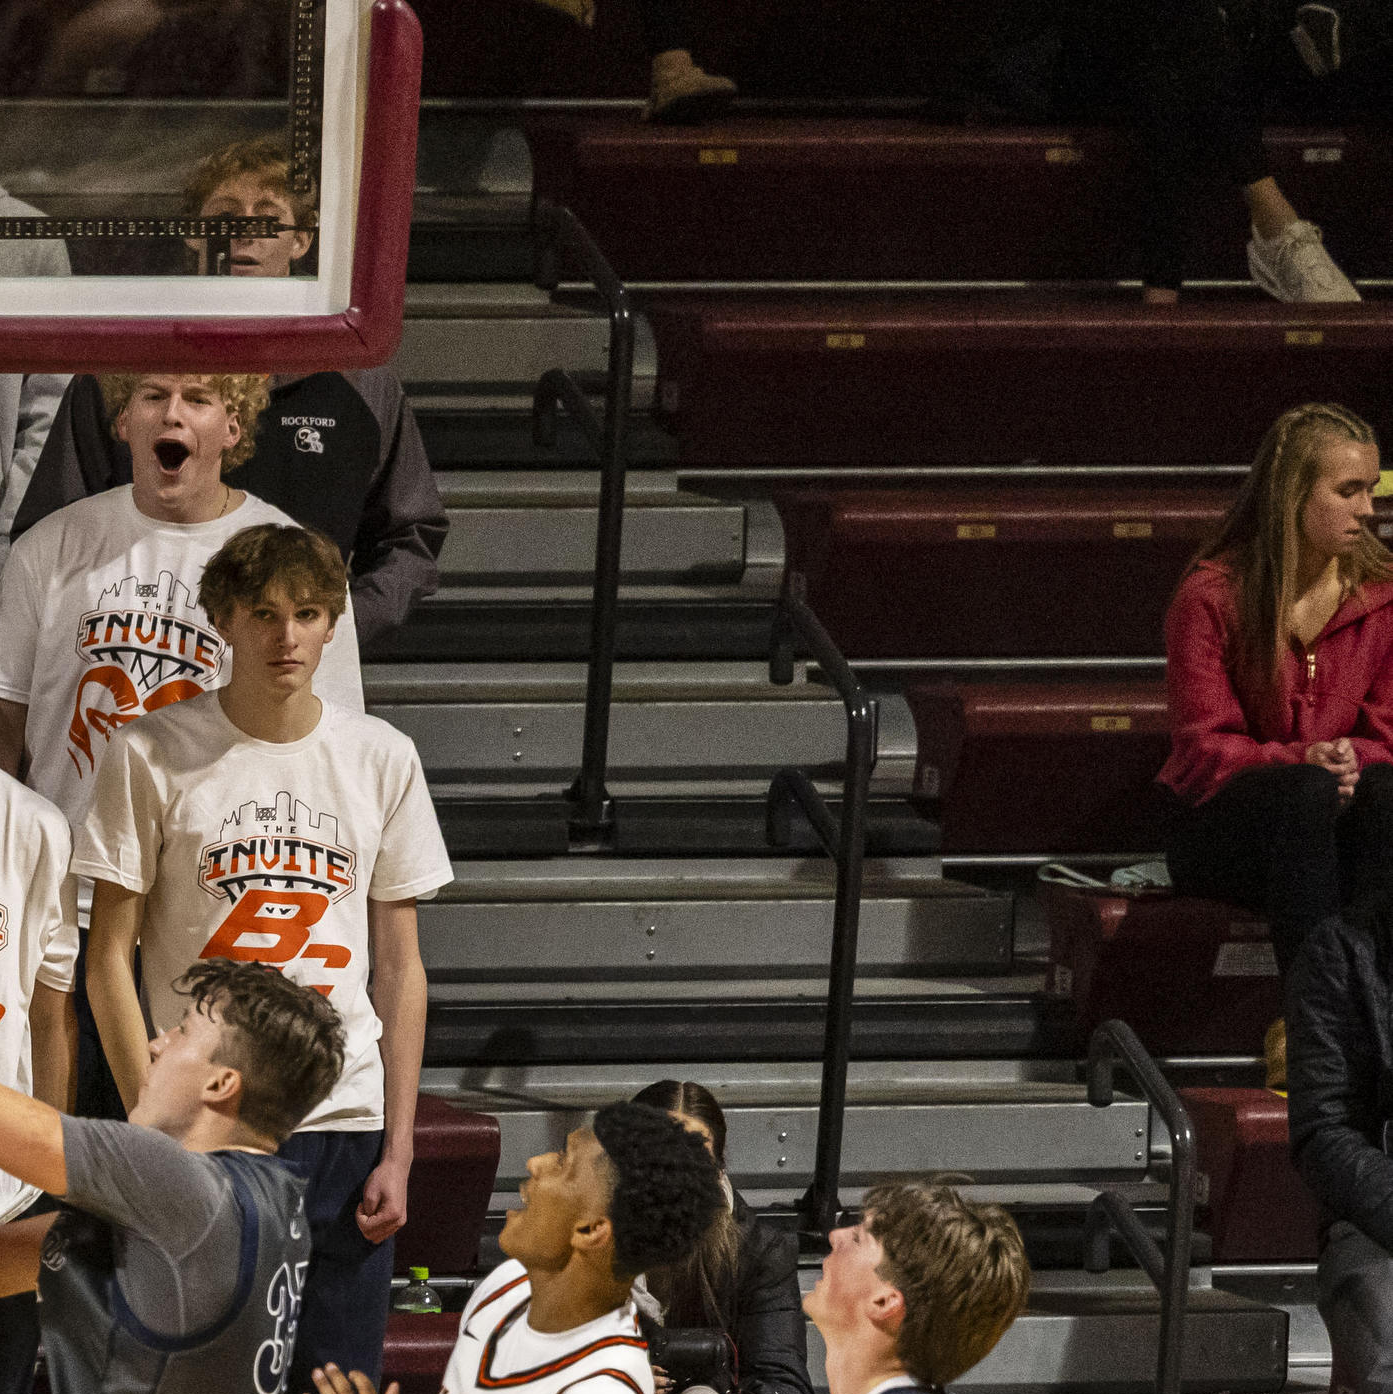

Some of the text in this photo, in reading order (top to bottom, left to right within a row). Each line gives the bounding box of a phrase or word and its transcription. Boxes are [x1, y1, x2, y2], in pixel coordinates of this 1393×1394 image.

[281, 416, 336, 427] ROCKFORD
[143, 602, 173, 613] THE
[82, 613, 220, 668] INVITE
[264, 825, 297, 834] THE
[206, 839, 350, 886] INVITE
